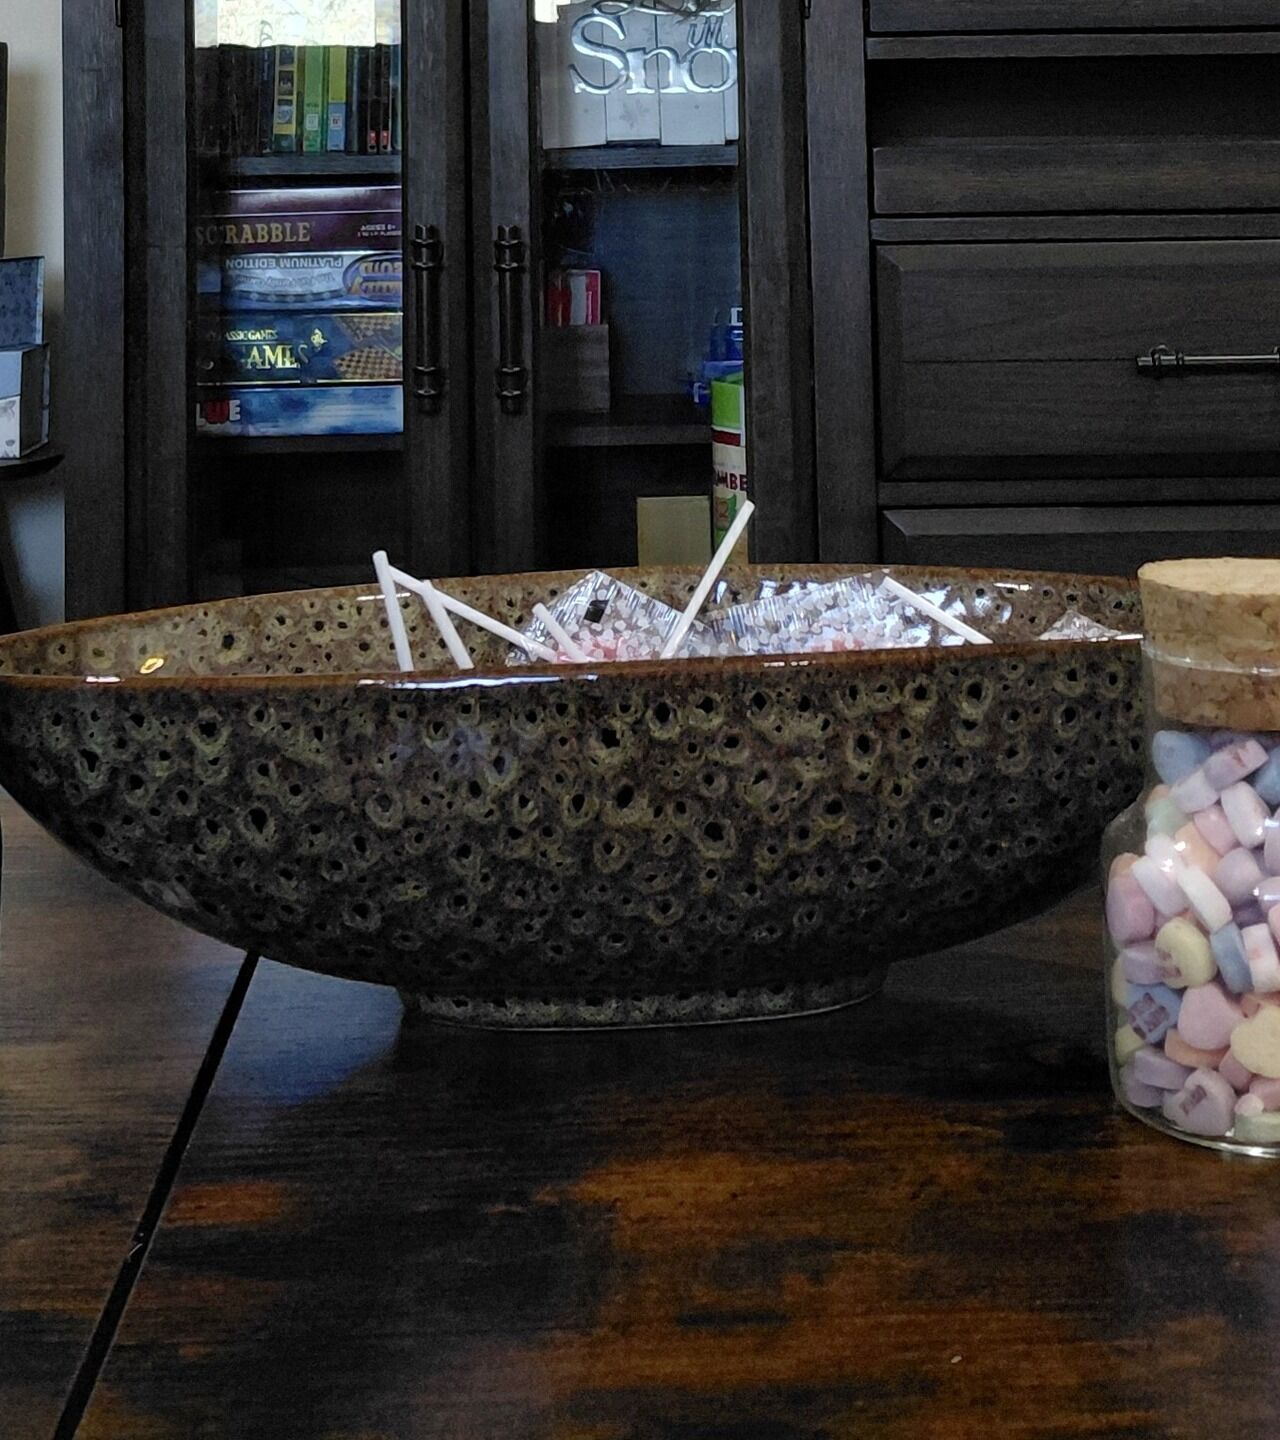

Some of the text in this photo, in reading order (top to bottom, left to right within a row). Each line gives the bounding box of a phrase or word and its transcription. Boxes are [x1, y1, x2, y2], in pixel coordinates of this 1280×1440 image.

[568, 12, 737, 94] Sno
[194, 221, 312, 246] SCRABBLE
[225, 254, 344, 270] PLATINUM EDITION
[243, 344, 310, 370] AMES
[195, 398, 241, 427] LUE
